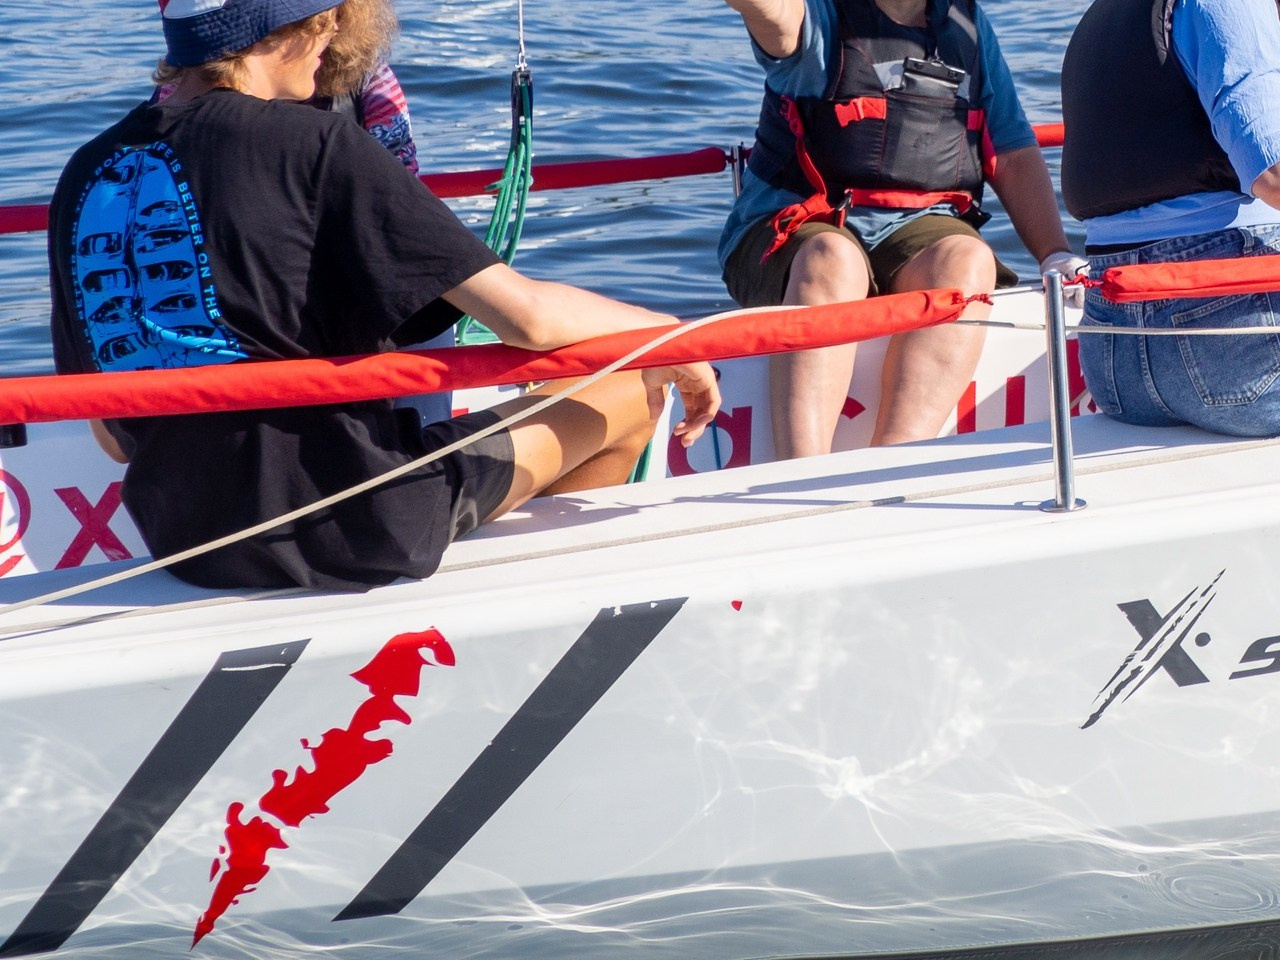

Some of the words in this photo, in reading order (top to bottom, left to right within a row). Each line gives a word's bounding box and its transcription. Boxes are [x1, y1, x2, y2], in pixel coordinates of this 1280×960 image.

[144, 141, 173, 158] LIFE
[170, 158, 182, 173] IS
[178, 182, 204, 246] BETTER
[198, 252, 212, 279] ON
[204, 284, 221, 320] THE
